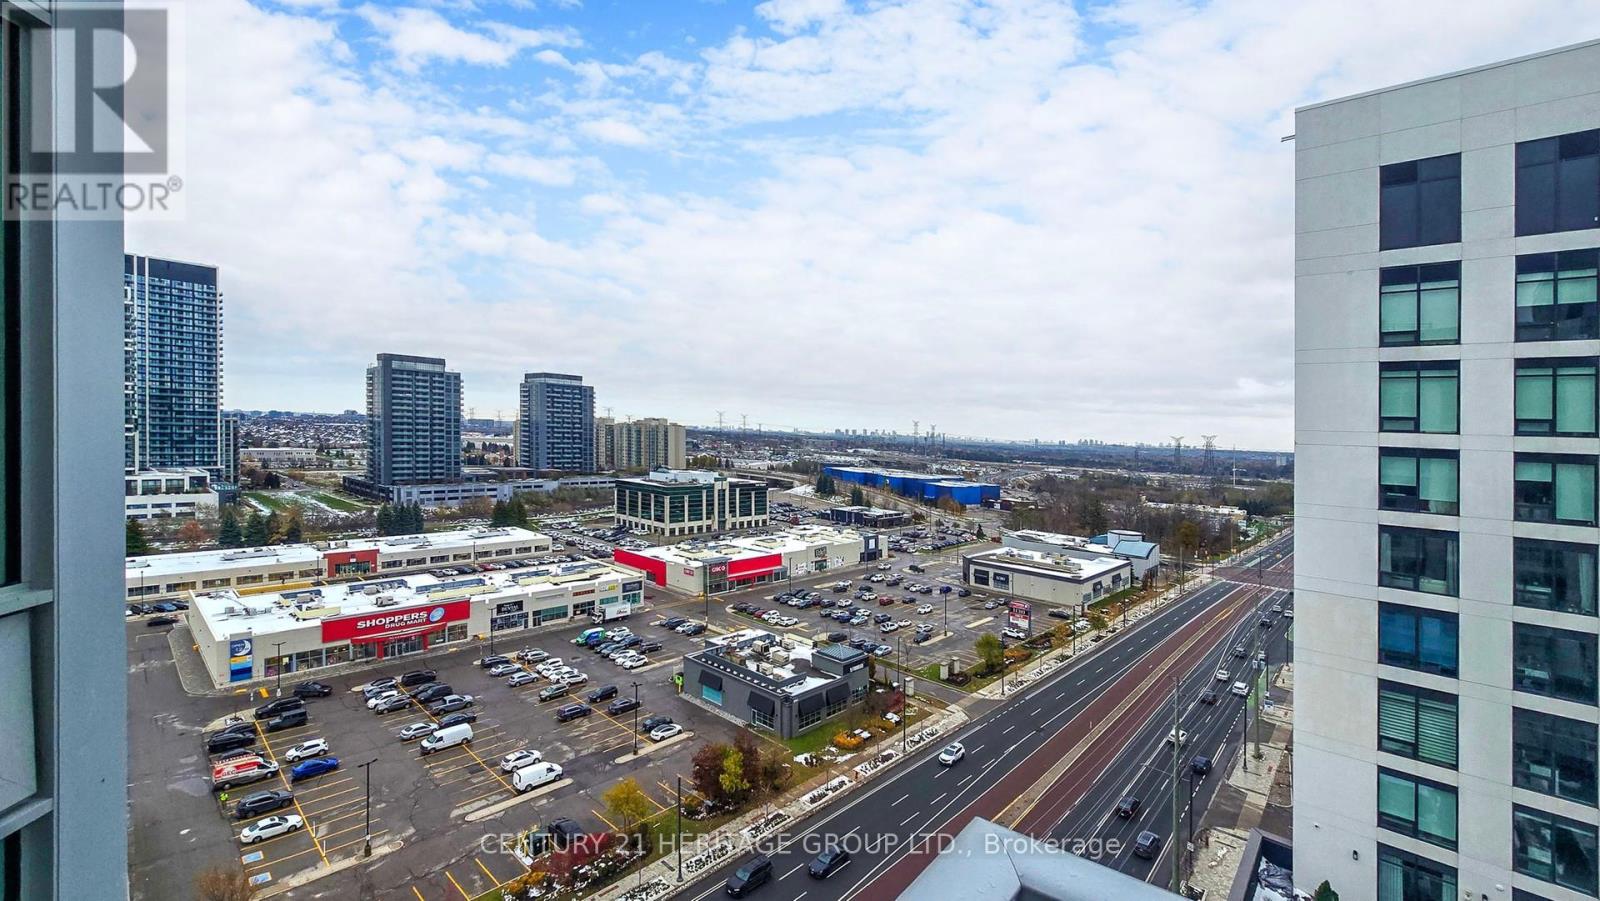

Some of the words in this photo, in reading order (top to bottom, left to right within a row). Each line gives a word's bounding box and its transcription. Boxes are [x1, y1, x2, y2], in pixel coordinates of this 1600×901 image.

[356, 611, 428, 629] SHOPPERS
[384, 621, 406, 629] DRUG
[406, 618, 427, 626] MART
